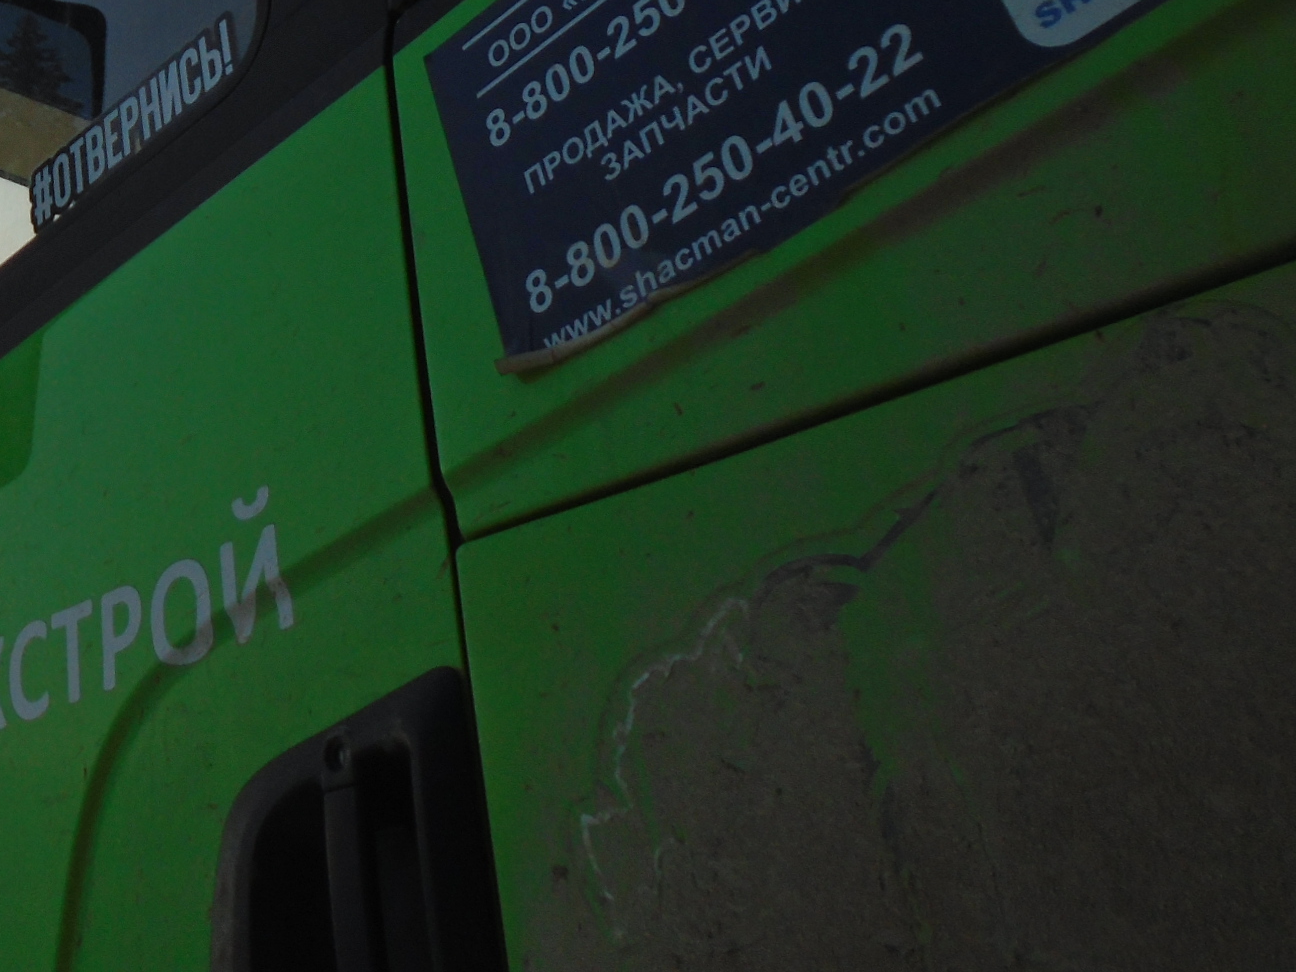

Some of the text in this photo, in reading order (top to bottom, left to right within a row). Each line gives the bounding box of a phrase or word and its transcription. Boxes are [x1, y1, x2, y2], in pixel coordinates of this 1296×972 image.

[487, 5, 554, 67] ООО
[600, 45, 773, 182] ЗАПЧАСТИ
[33, 19, 235, 227] #ОТВЕРНИСЬ!
[523, 73, 686, 195] ПРОДАЖА,
[524, 23, 925, 314] 8-800-250-40-22
[543, 88, 942, 351] www.shacman-centr.com
